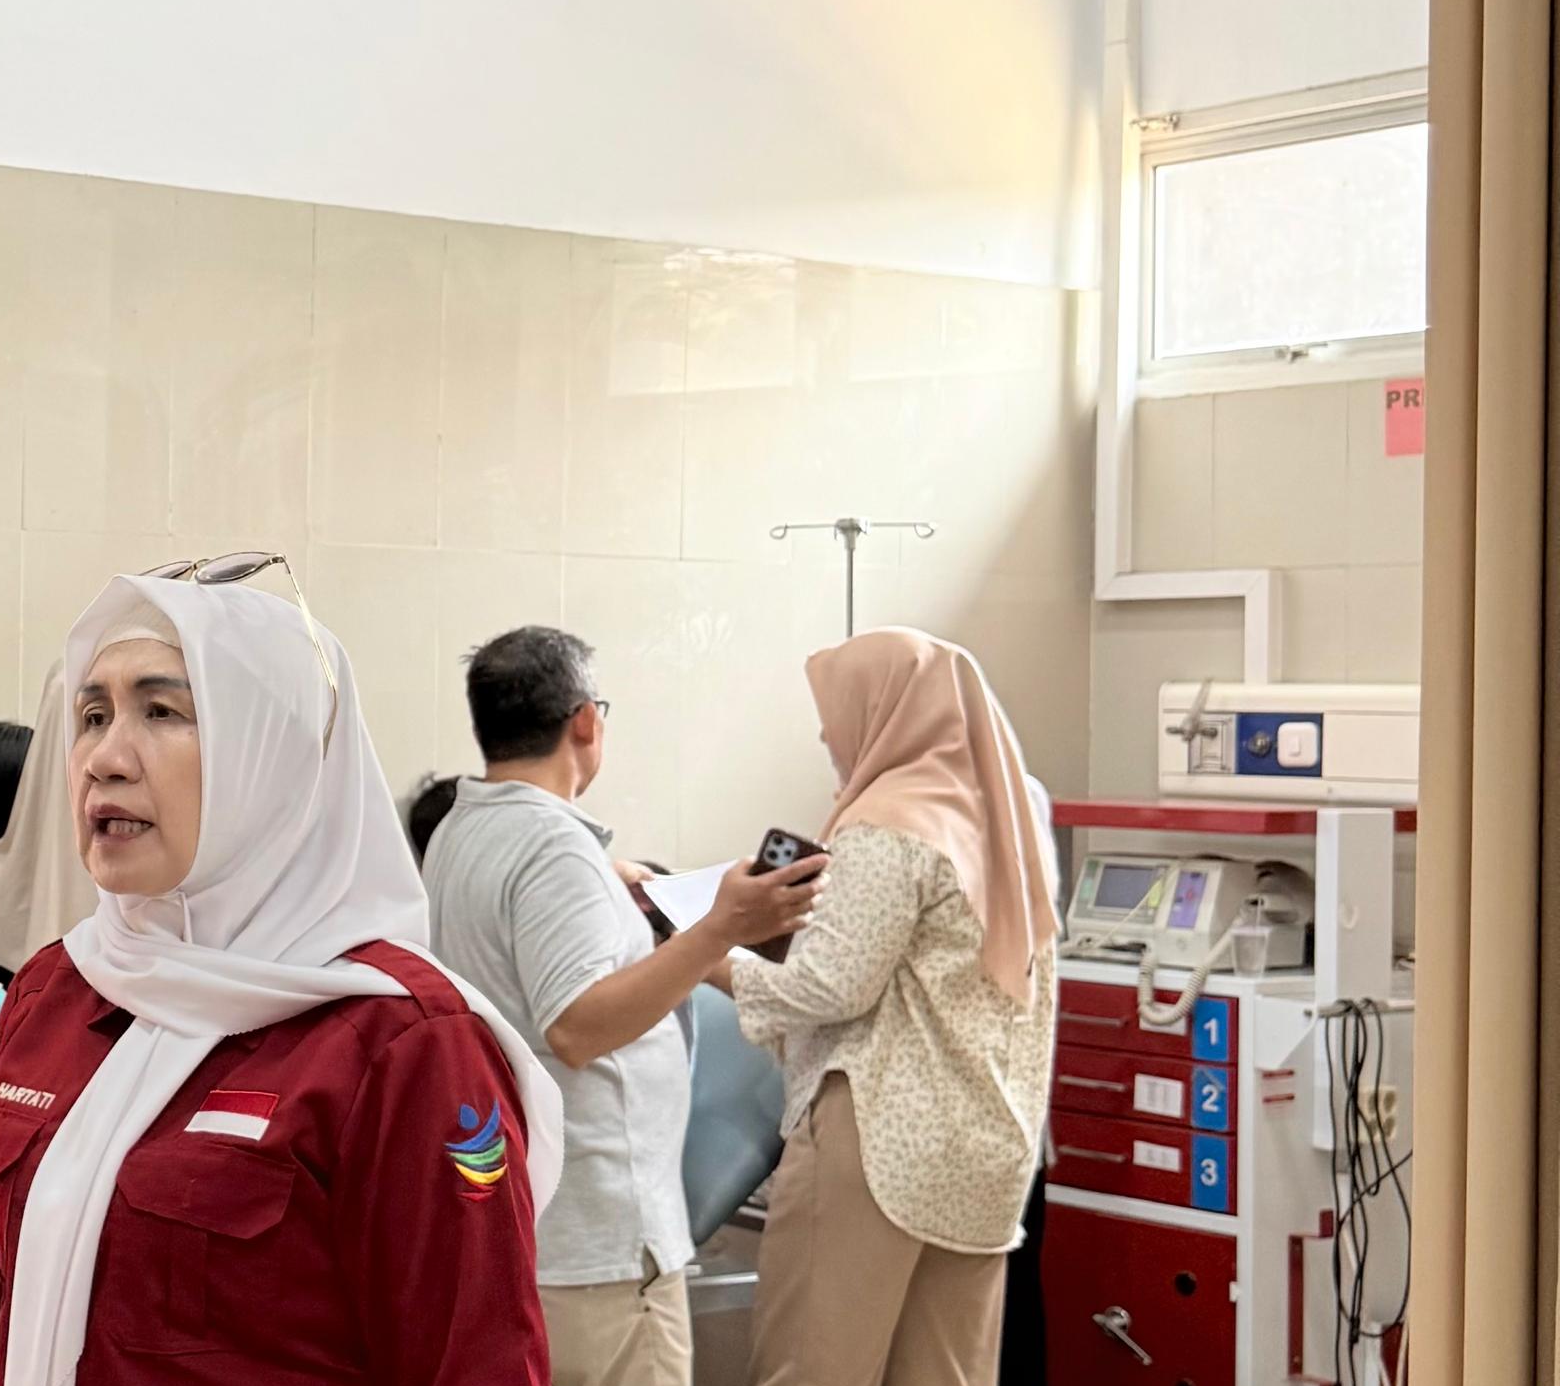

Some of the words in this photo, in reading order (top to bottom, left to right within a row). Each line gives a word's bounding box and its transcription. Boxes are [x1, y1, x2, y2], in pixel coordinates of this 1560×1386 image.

[1385, 388, 1424, 410] PR
[1203, 1018, 1218, 1046] 1
[1201, 1084, 1219, 1113] 2
[1199, 1158, 1218, 1187] 3
